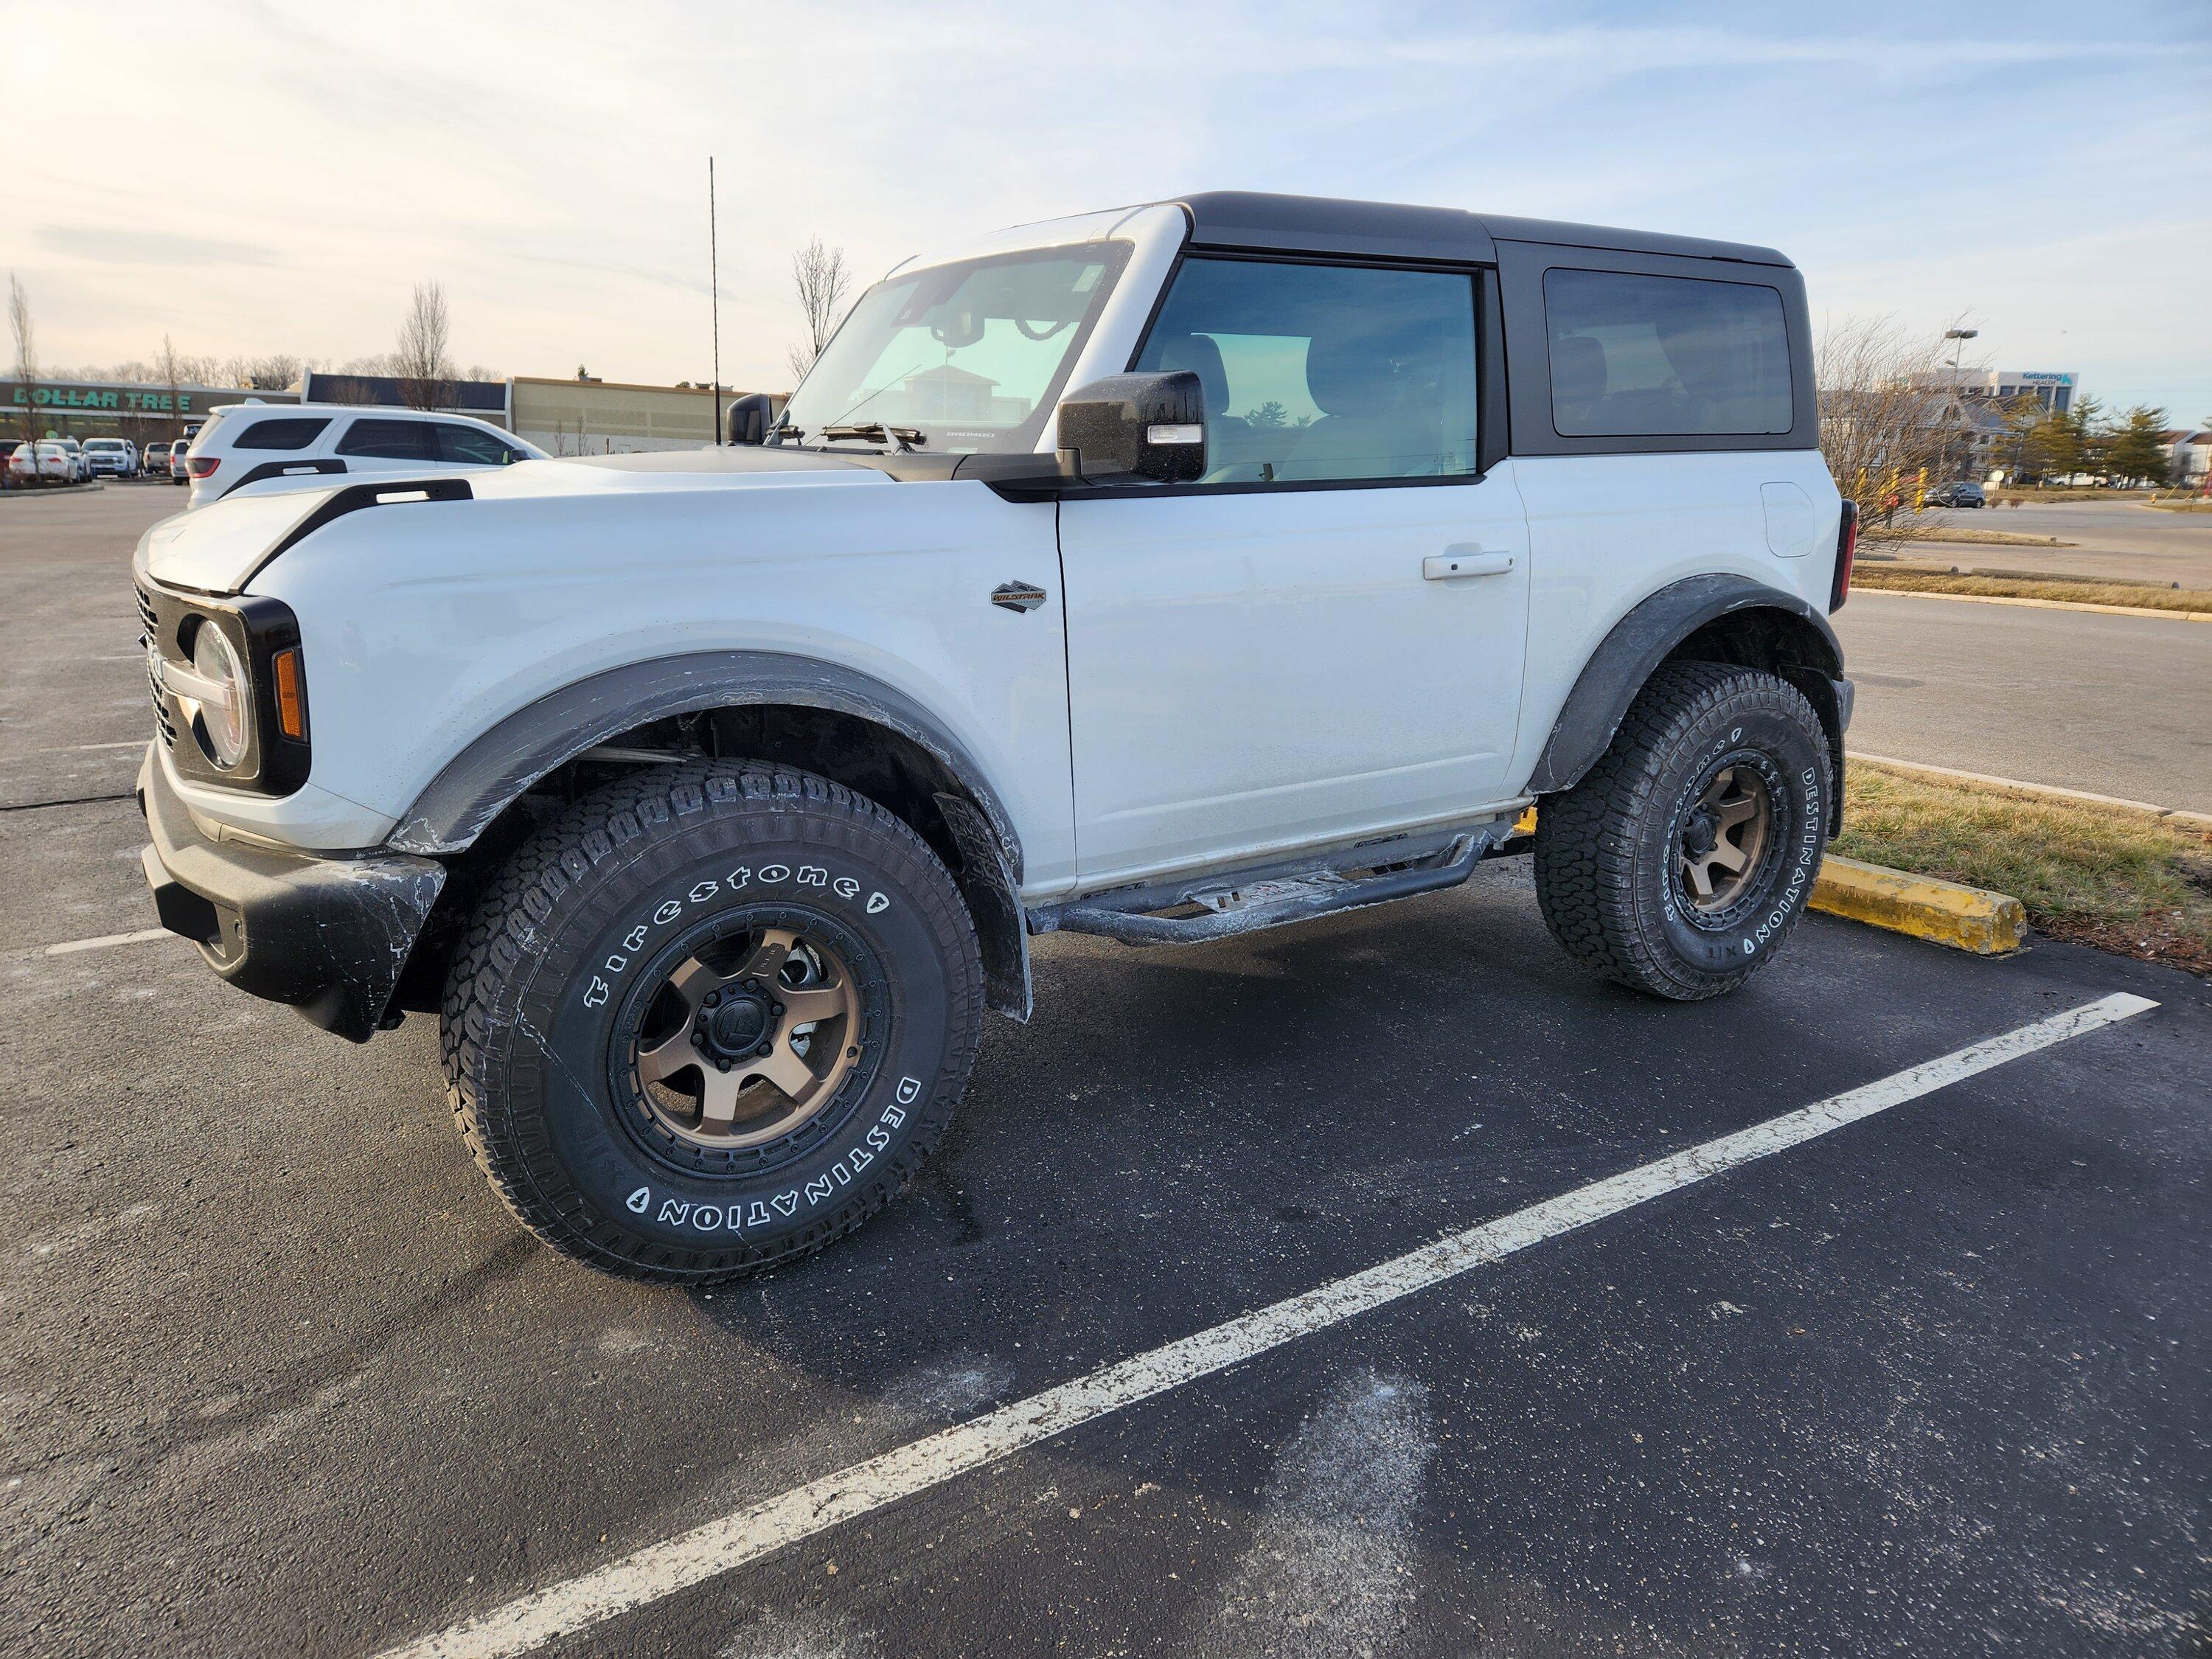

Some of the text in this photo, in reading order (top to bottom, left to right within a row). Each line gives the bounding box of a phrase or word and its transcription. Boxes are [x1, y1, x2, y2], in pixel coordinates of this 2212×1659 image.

[2023, 372, 2062, 380] Kettering
[13, 387, 191, 411] DOLLAR TREE
[993, 593, 1044, 601] WILDTRAK
[1756, 767, 1819, 944] DESTINATION
[658, 1076, 922, 1231] DESTINATION
